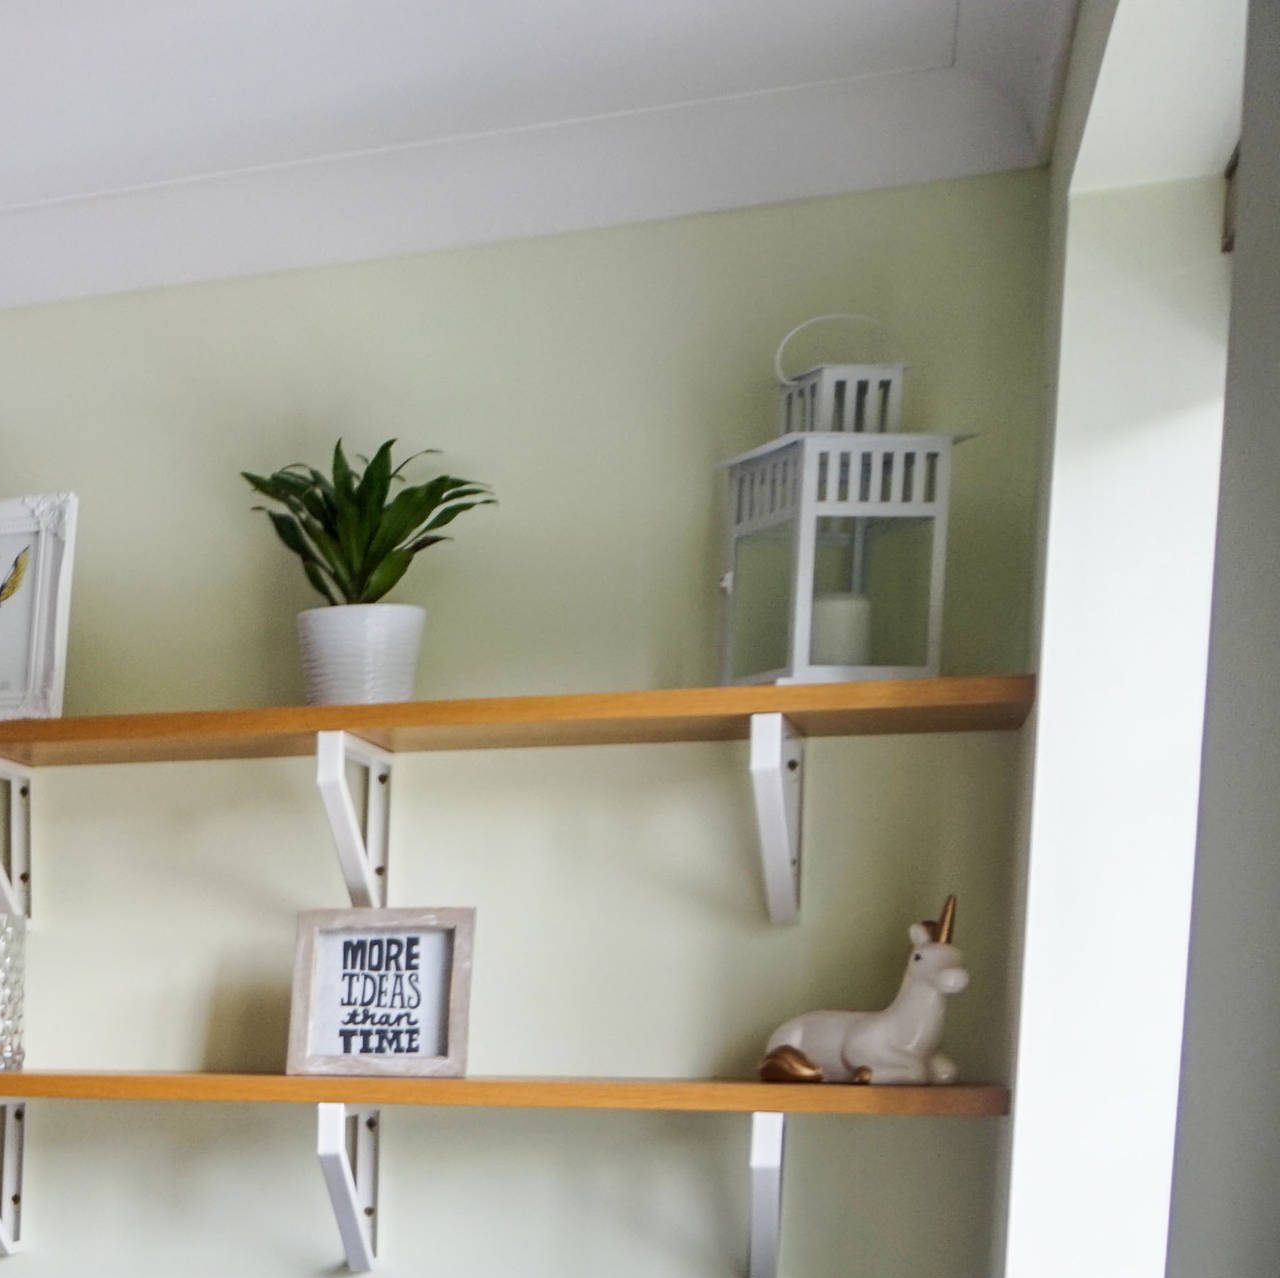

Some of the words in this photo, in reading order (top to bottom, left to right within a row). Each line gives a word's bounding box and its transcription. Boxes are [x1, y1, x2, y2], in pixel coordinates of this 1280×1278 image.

[342, 936, 420, 972] MORE
[340, 972, 422, 1010] IDEAS
[341, 1008, 418, 1027] than
[338, 1027, 420, 1054] TIME
